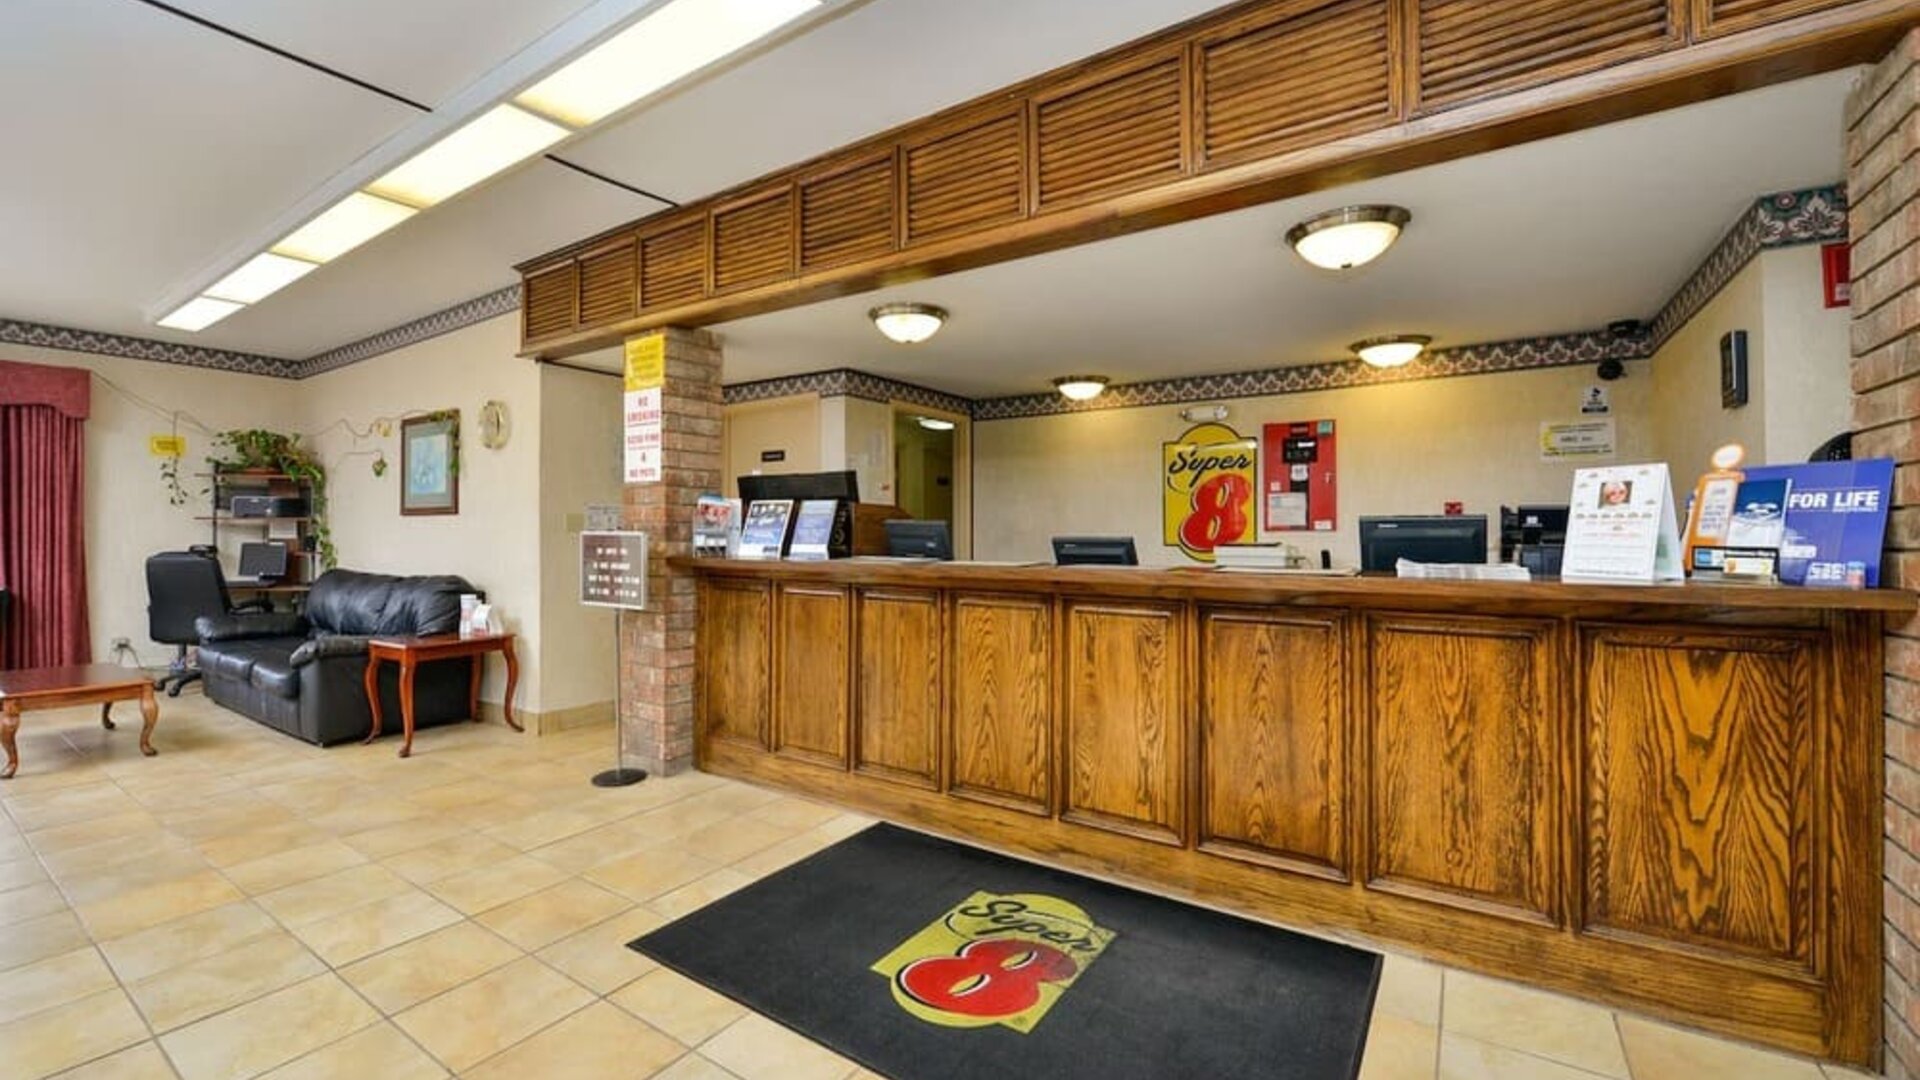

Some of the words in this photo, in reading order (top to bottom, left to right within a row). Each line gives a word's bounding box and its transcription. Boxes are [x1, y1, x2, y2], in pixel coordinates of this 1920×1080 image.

[1168, 450, 1252, 488] Super
[1179, 473, 1252, 554] 8
[1789, 491, 1828, 509] FOR
[1834, 490, 1880, 508] LIFE
[958, 900, 1099, 951] Super
[895, 937, 1078, 1018] 8
